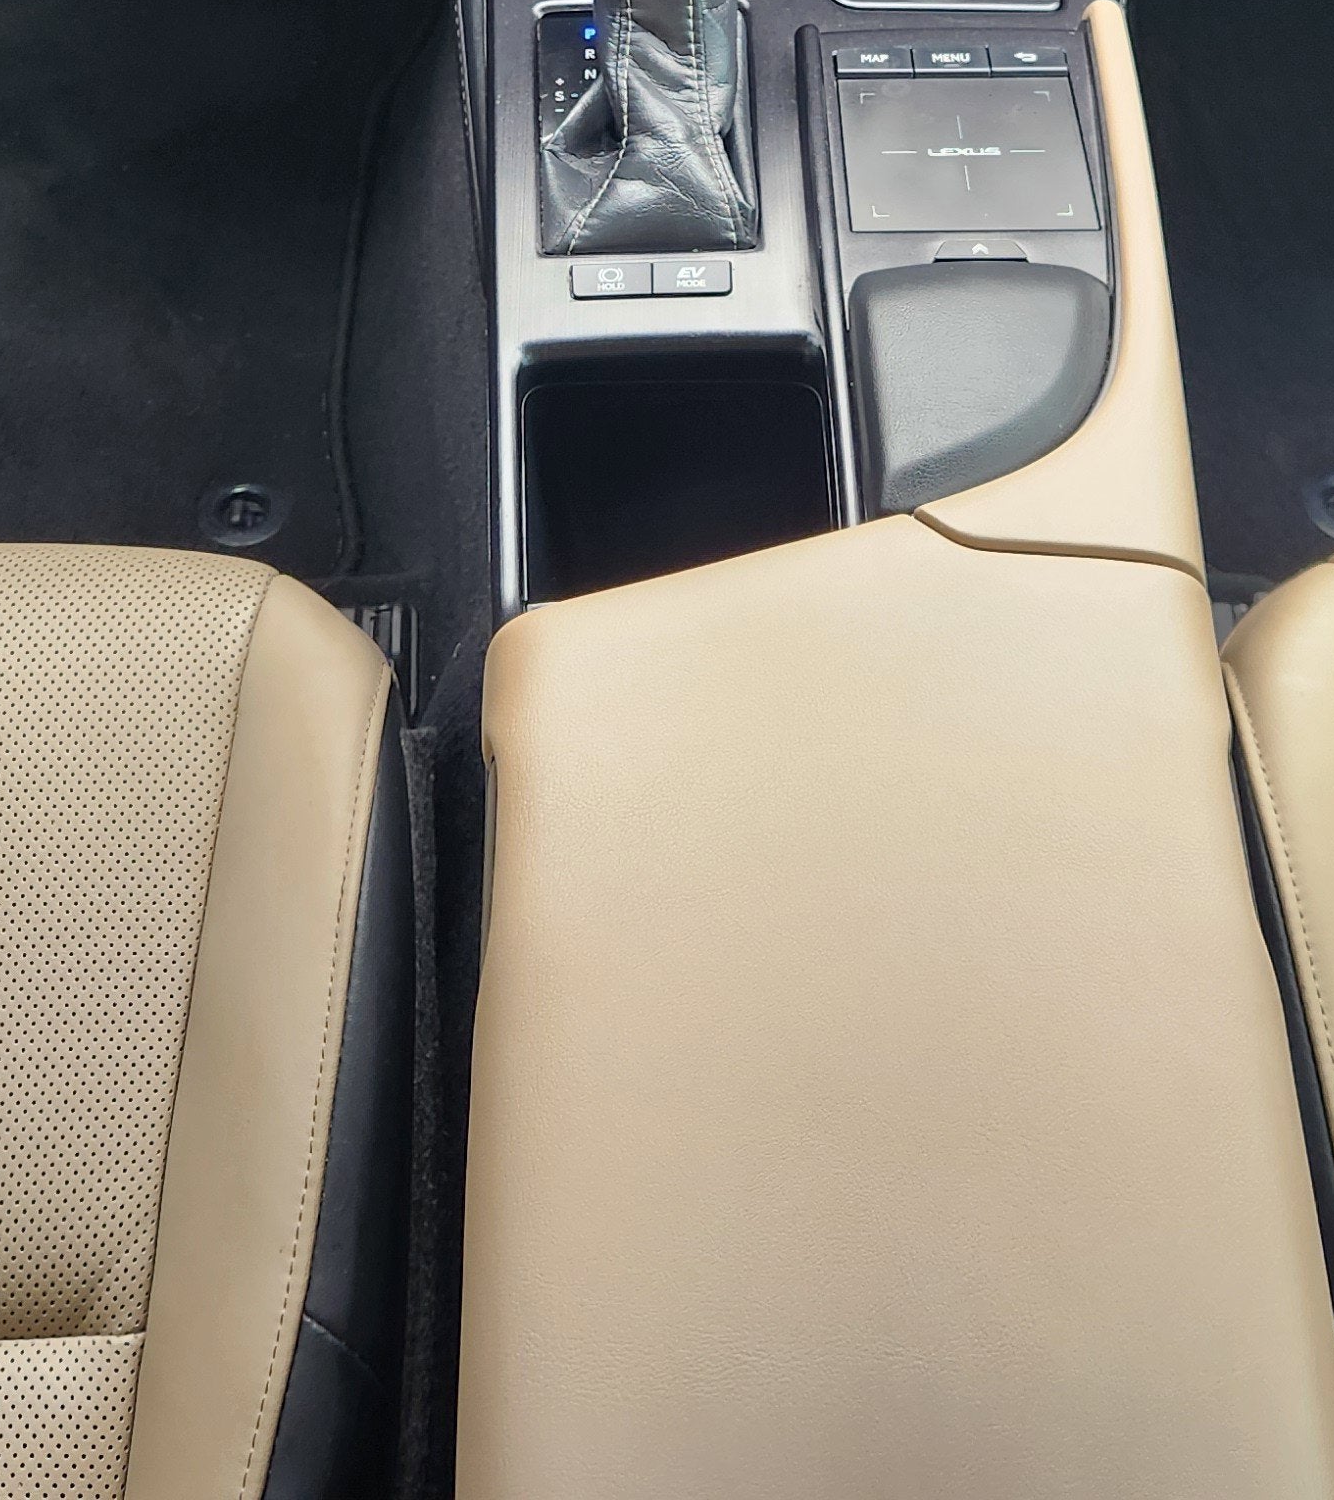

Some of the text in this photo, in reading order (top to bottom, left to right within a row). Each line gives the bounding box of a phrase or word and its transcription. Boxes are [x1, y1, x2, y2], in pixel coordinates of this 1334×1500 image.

[584, 27, 597, 40] P
[584, 48, 597, 60] R
[859, 53, 889, 63] MAP
[930, 52, 971, 64] MENU
[584, 68, 598, 80] N
[554, 90, 566, 102] S
[926, 146, 1002, 157] LEXUS
[676, 266, 707, 279] EV
[596, 282, 626, 292] HOLD
[675, 279, 707, 289] MODE
